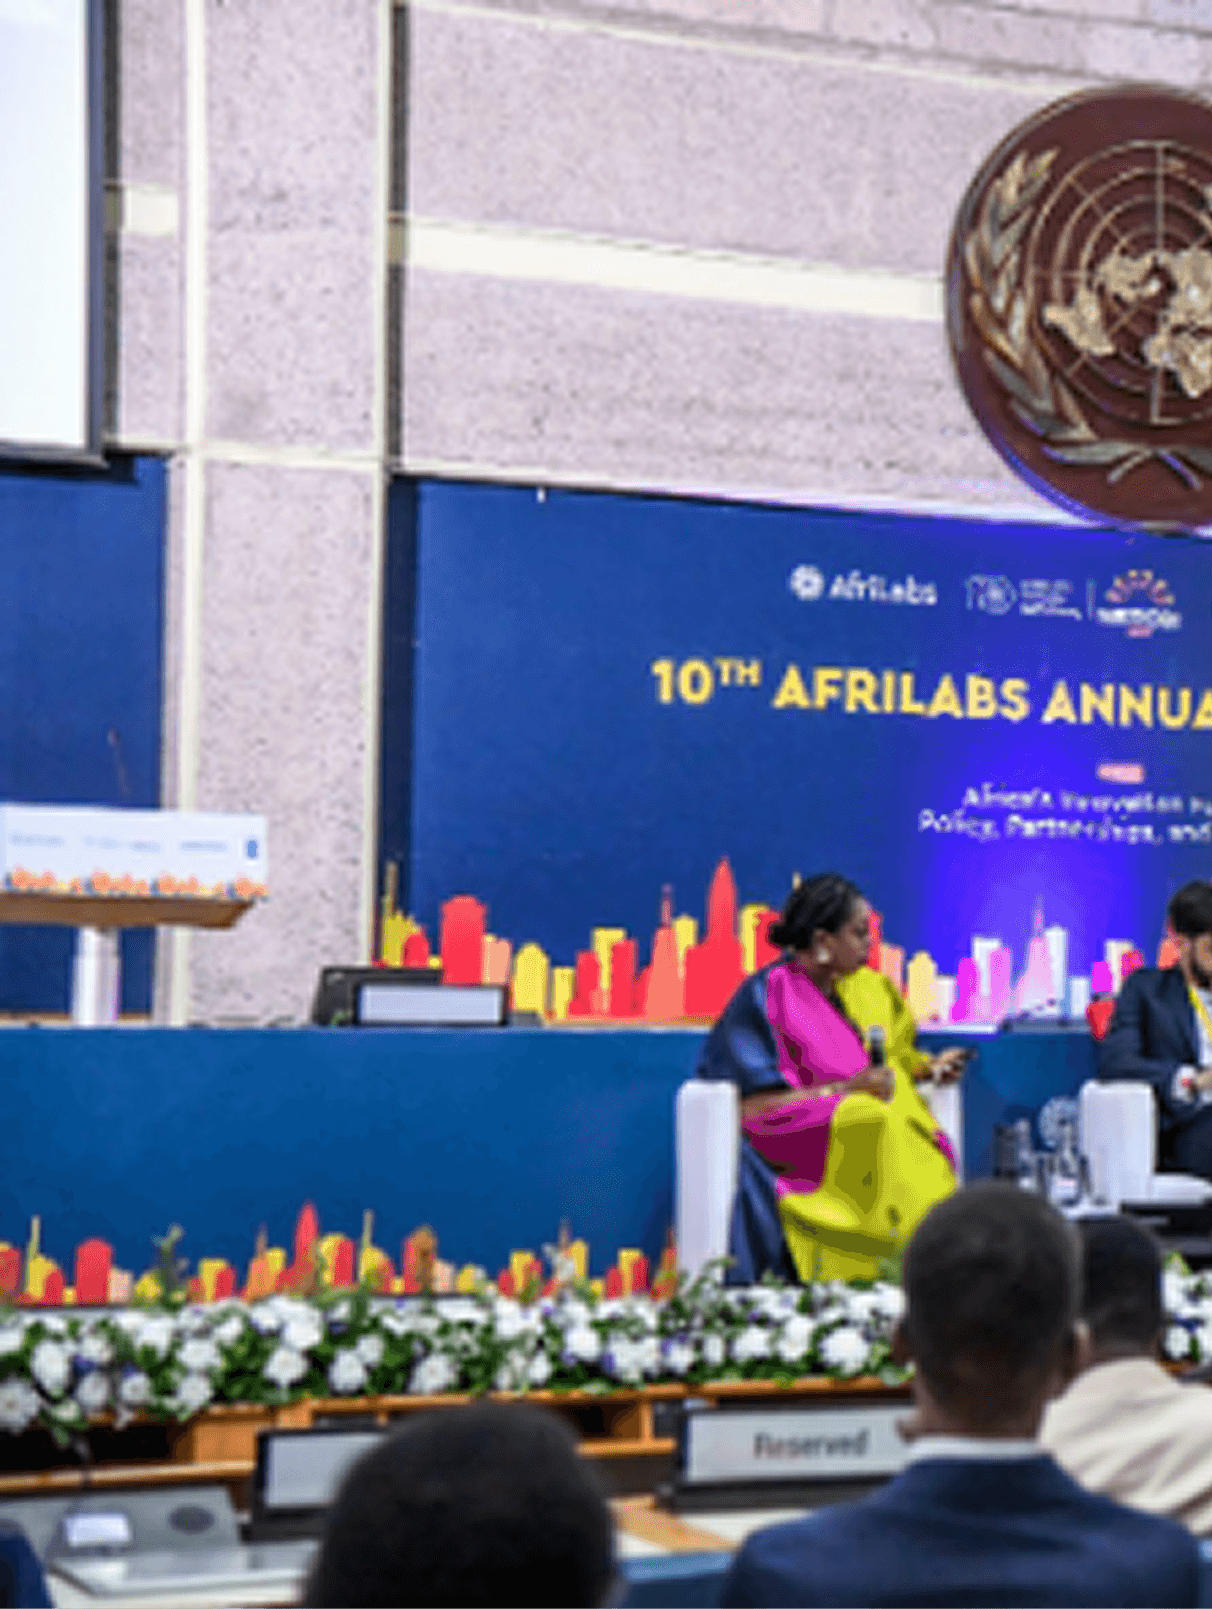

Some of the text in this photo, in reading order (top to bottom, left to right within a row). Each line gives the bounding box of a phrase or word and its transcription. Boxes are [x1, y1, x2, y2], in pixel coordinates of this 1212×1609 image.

[652, 659, 761, 704] 10TH
[772, 665, 1030, 719] AFRILABS
[753, 1427, 871, 1459] Reserved
